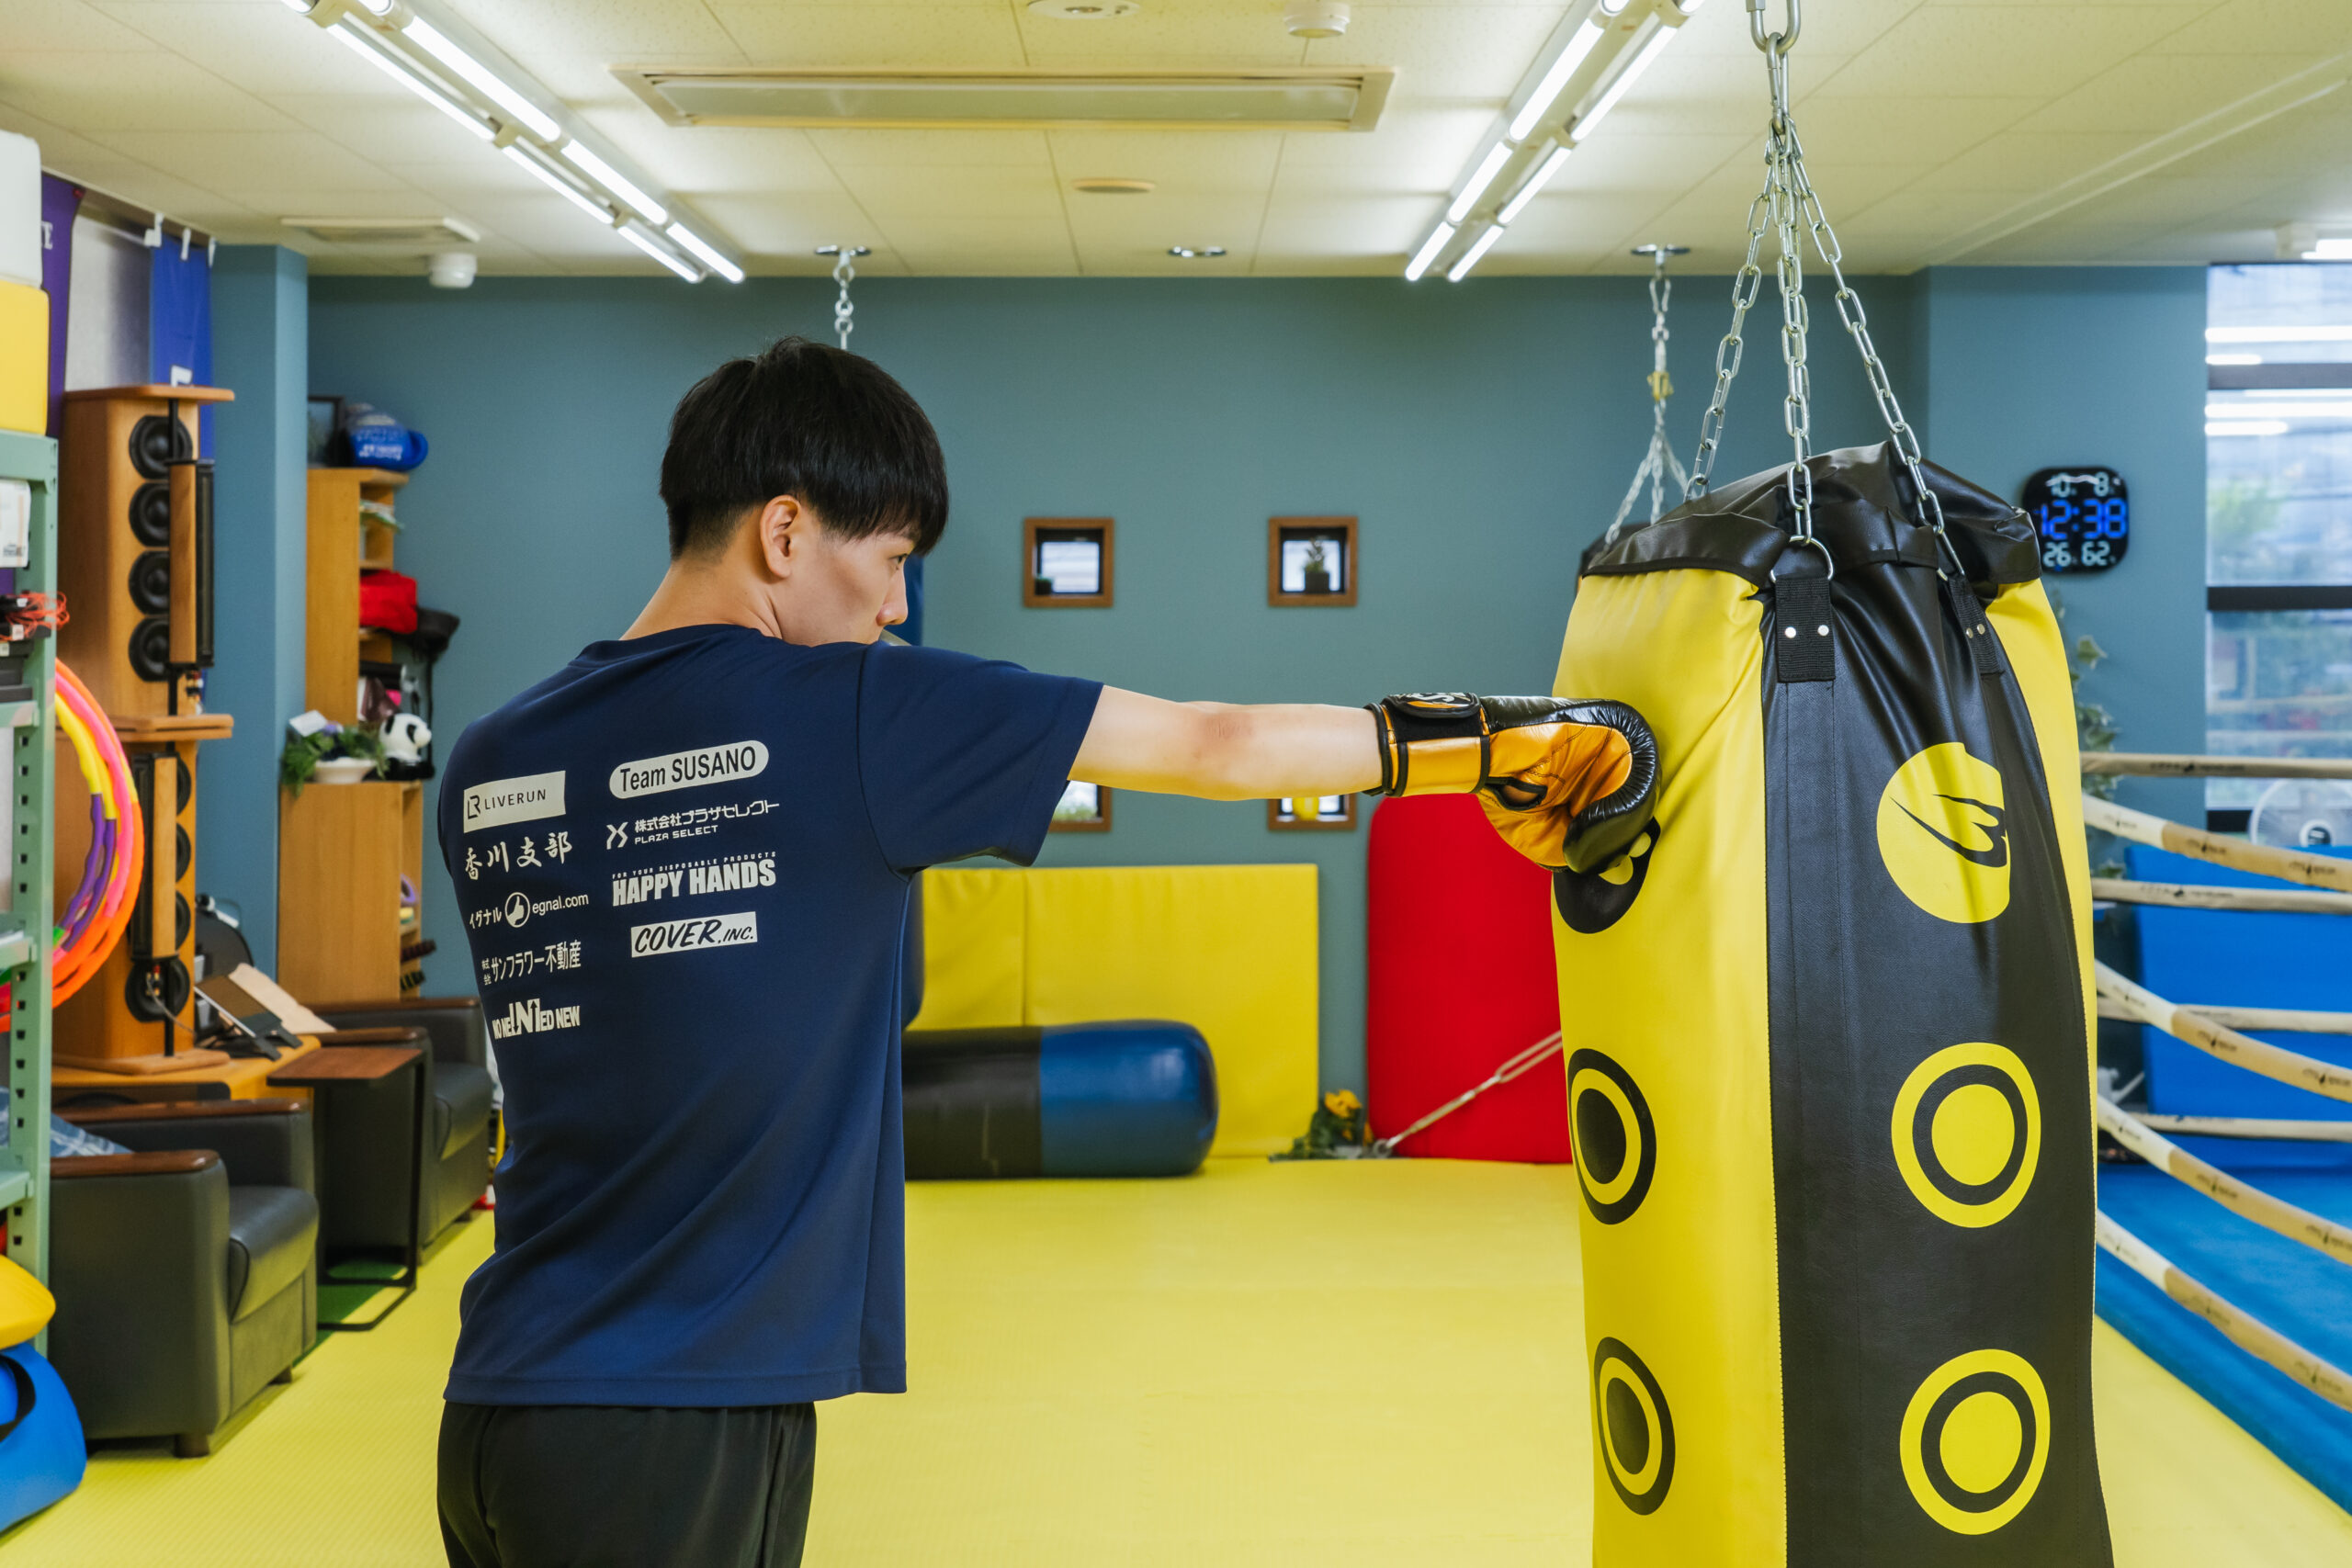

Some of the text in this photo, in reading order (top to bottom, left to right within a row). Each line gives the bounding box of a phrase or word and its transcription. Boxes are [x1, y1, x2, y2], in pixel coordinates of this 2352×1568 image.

[2040, 499, 2129, 540] 12:38
[619, 746, 756, 792] Team SUSANO
[484, 788, 546, 810] LIVERUN
[634, 799, 780, 833] 株式会社プラザセレクト
[634, 824, 718, 845] PLAZA SELECT
[464, 830, 573, 881] 香川支部
[612, 851, 776, 880] FOR YOUR DISPOSABLE PRODUCTS
[612, 858, 776, 907] HAPPY HANDS
[469, 894, 589, 930] イグナル egnal.com
[555, 1005, 581, 1030] NEW
